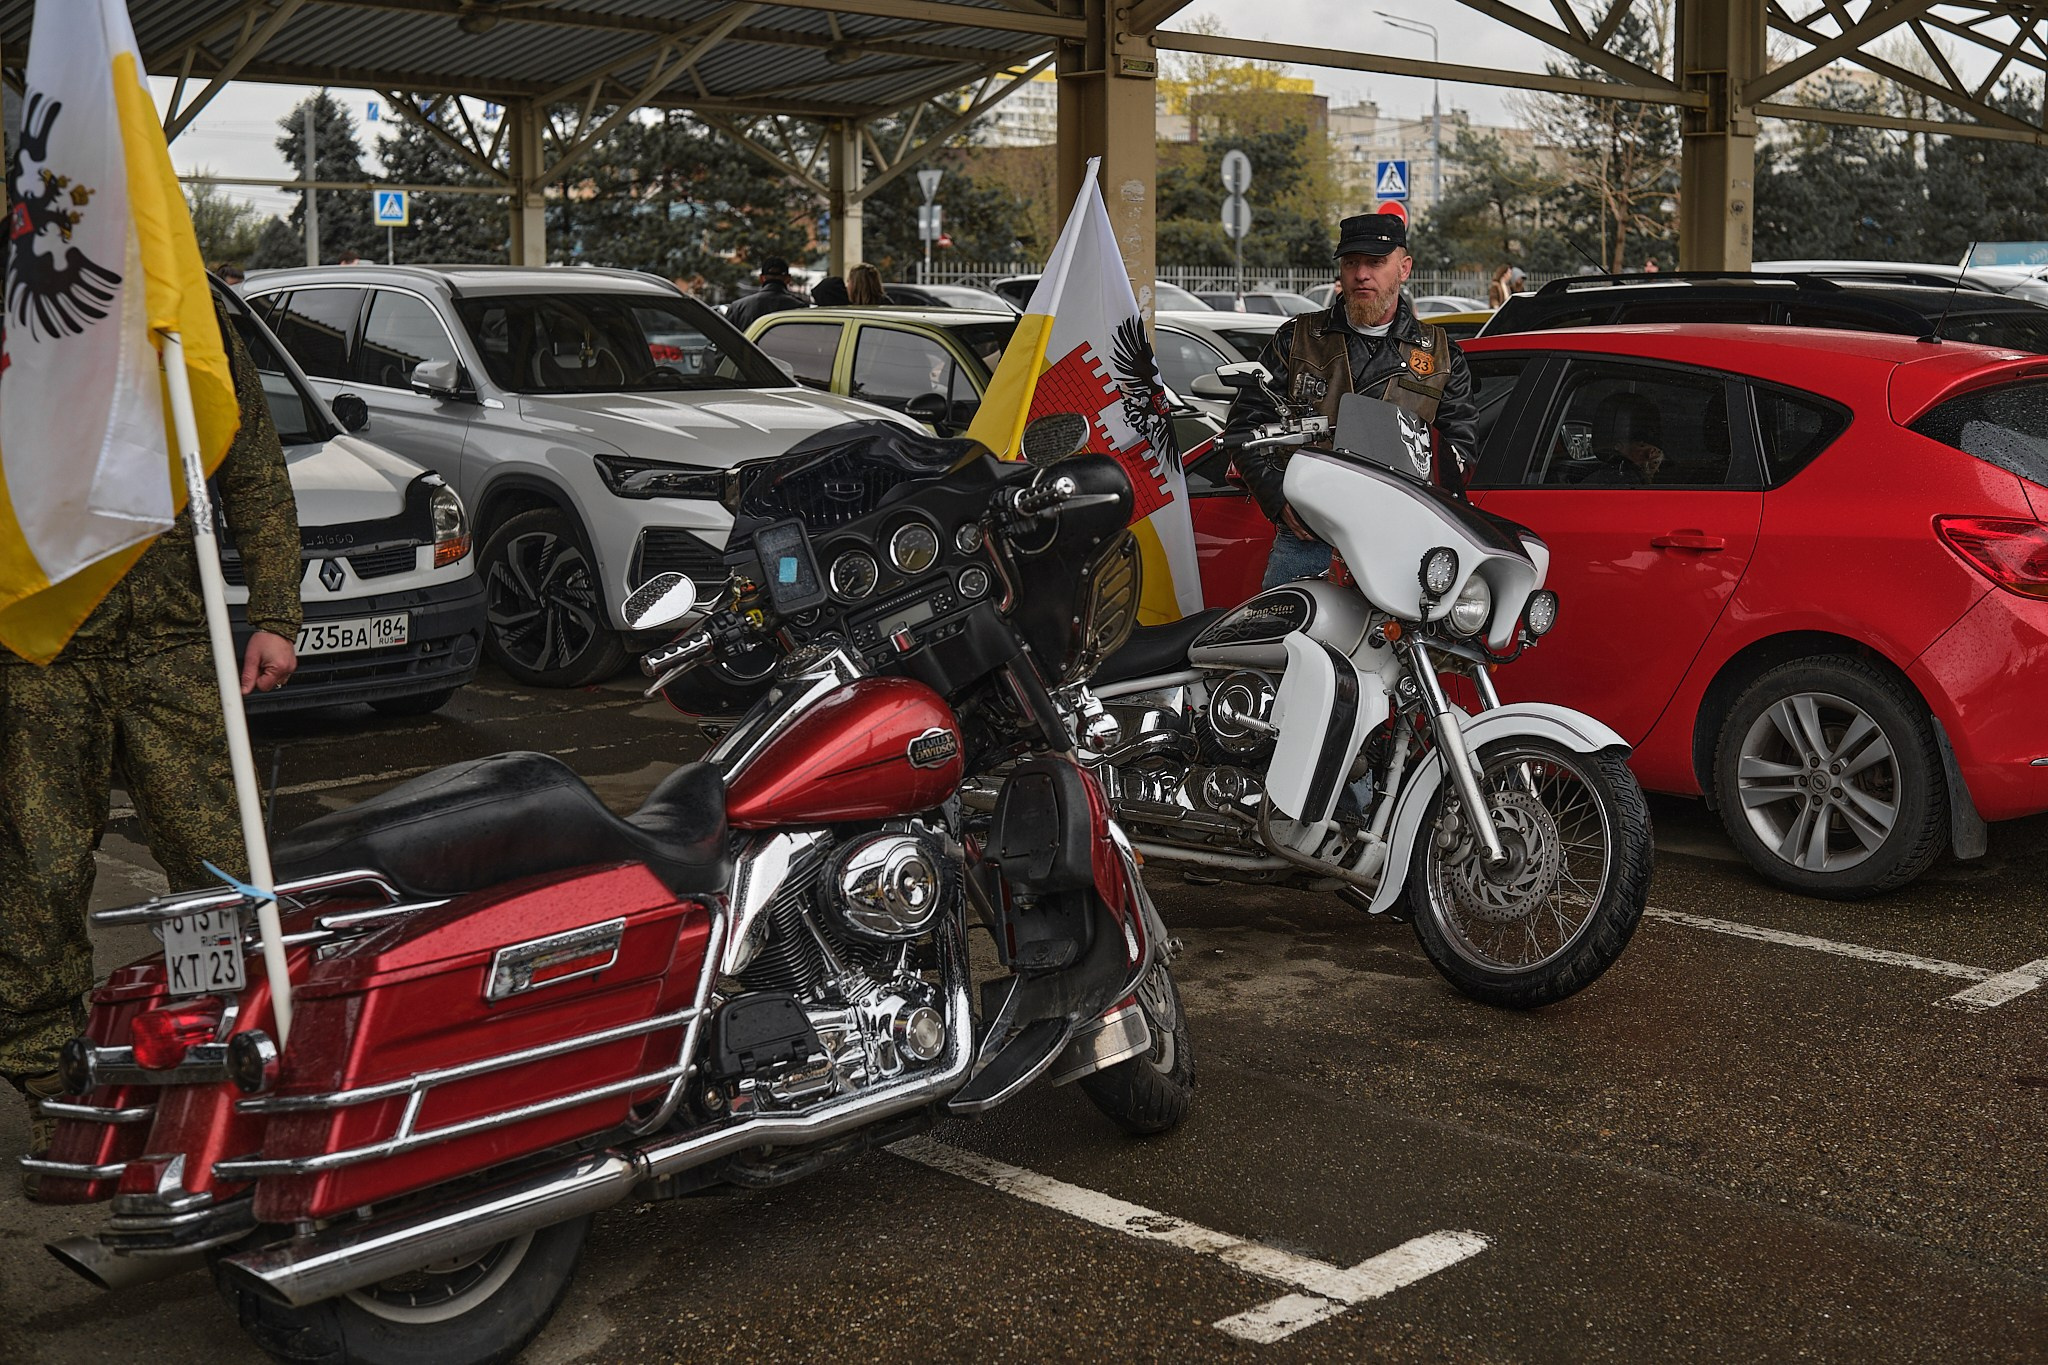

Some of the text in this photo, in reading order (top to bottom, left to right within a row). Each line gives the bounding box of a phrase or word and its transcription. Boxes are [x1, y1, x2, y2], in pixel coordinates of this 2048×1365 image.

[1414, 357, 1429, 372] 23
[372, 616, 405, 638] 184
[378, 636, 394, 645] RUS
[916, 742, 956, 760] DAVIDSON
[210, 949, 236, 984] 23
